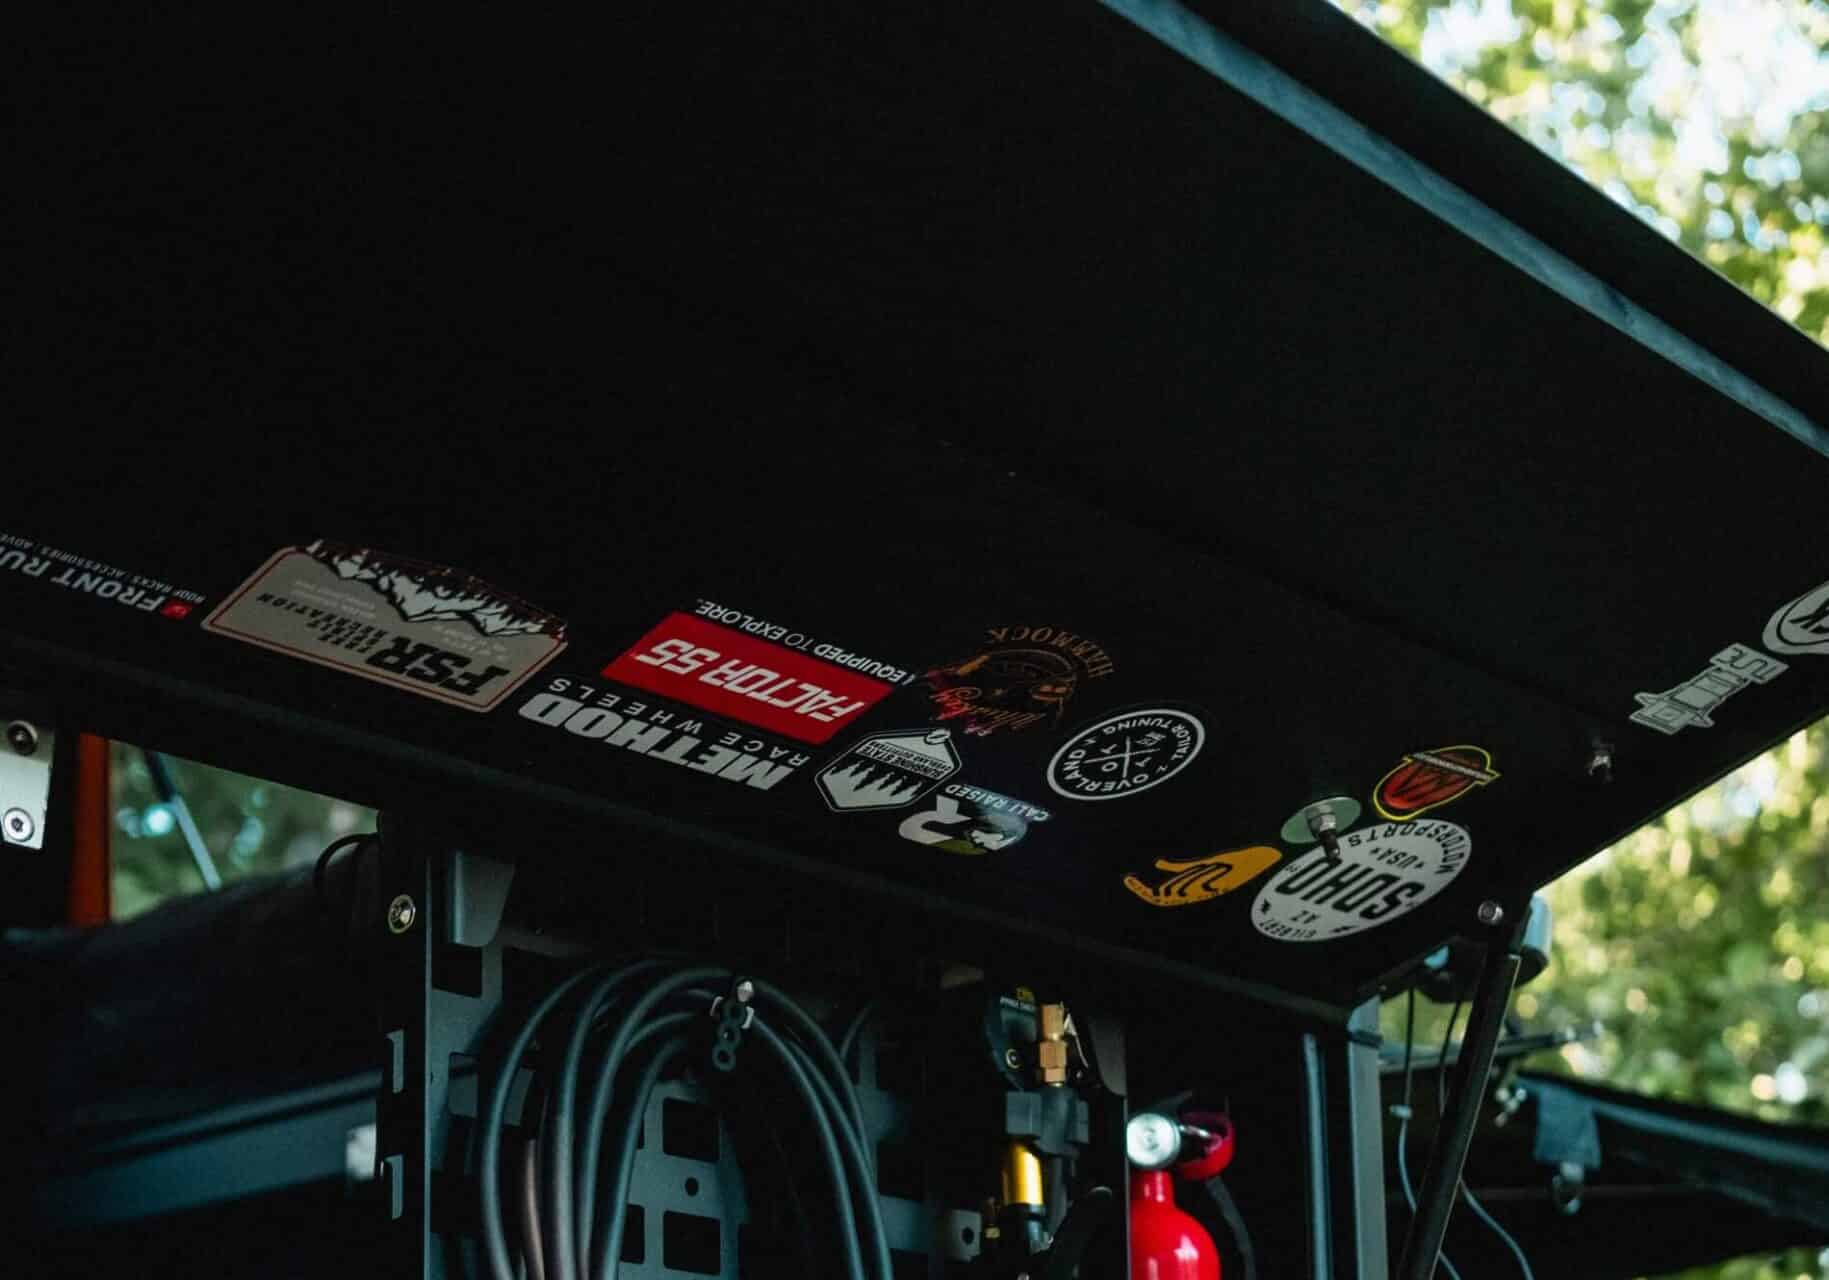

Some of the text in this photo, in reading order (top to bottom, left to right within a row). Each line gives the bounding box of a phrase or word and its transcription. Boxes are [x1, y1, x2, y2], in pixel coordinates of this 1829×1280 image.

[0, 546, 167, 612] FRONT RU
[365, 636, 511, 697] FSR
[784, 633, 813, 651] TO
[815, 643, 904, 683] EQUIPPED
[634, 637, 866, 722] FACTOR 55
[517, 692, 796, 791] METHOD
[549, 677, 812, 768] RACE WHEELS
[1102, 717, 1193, 761] TAILOR TUNING
[1063, 749, 1149, 792] OVERLAND
[944, 783, 1050, 823] CALI RAISED
[1348, 820, 1466, 876] MOTORSPORTS
[1376, 848, 1420, 871] USA
[1274, 855, 1426, 920] SOHO
